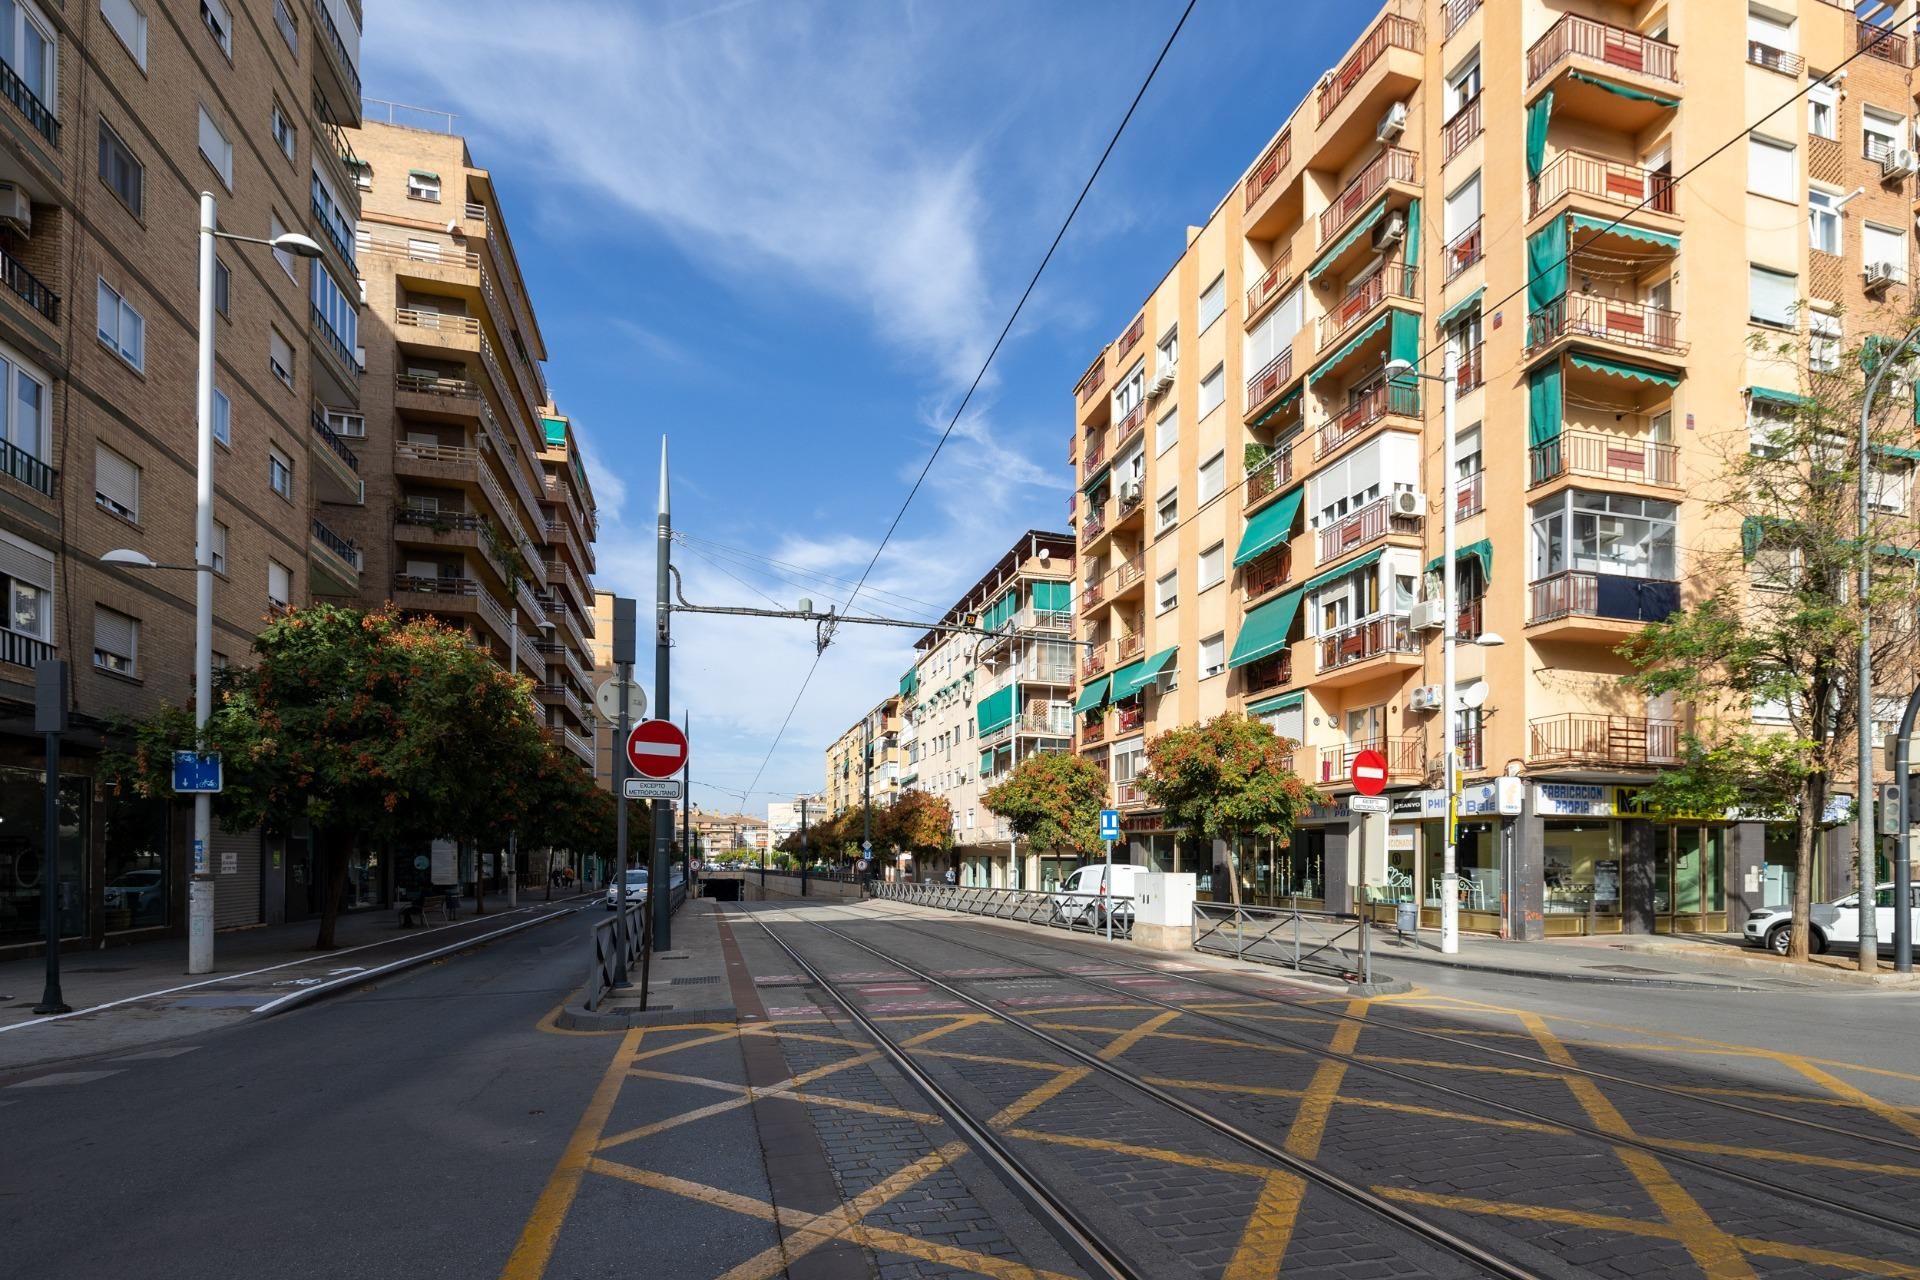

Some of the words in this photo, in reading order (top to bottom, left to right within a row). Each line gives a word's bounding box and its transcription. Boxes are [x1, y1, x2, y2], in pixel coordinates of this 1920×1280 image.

[628, 789, 677, 797] METROPOLITANO
[1541, 784, 1603, 800] FABRICACION
[1399, 801, 1421, 809] SANYO
[1555, 800, 1590, 814] PROPIA
